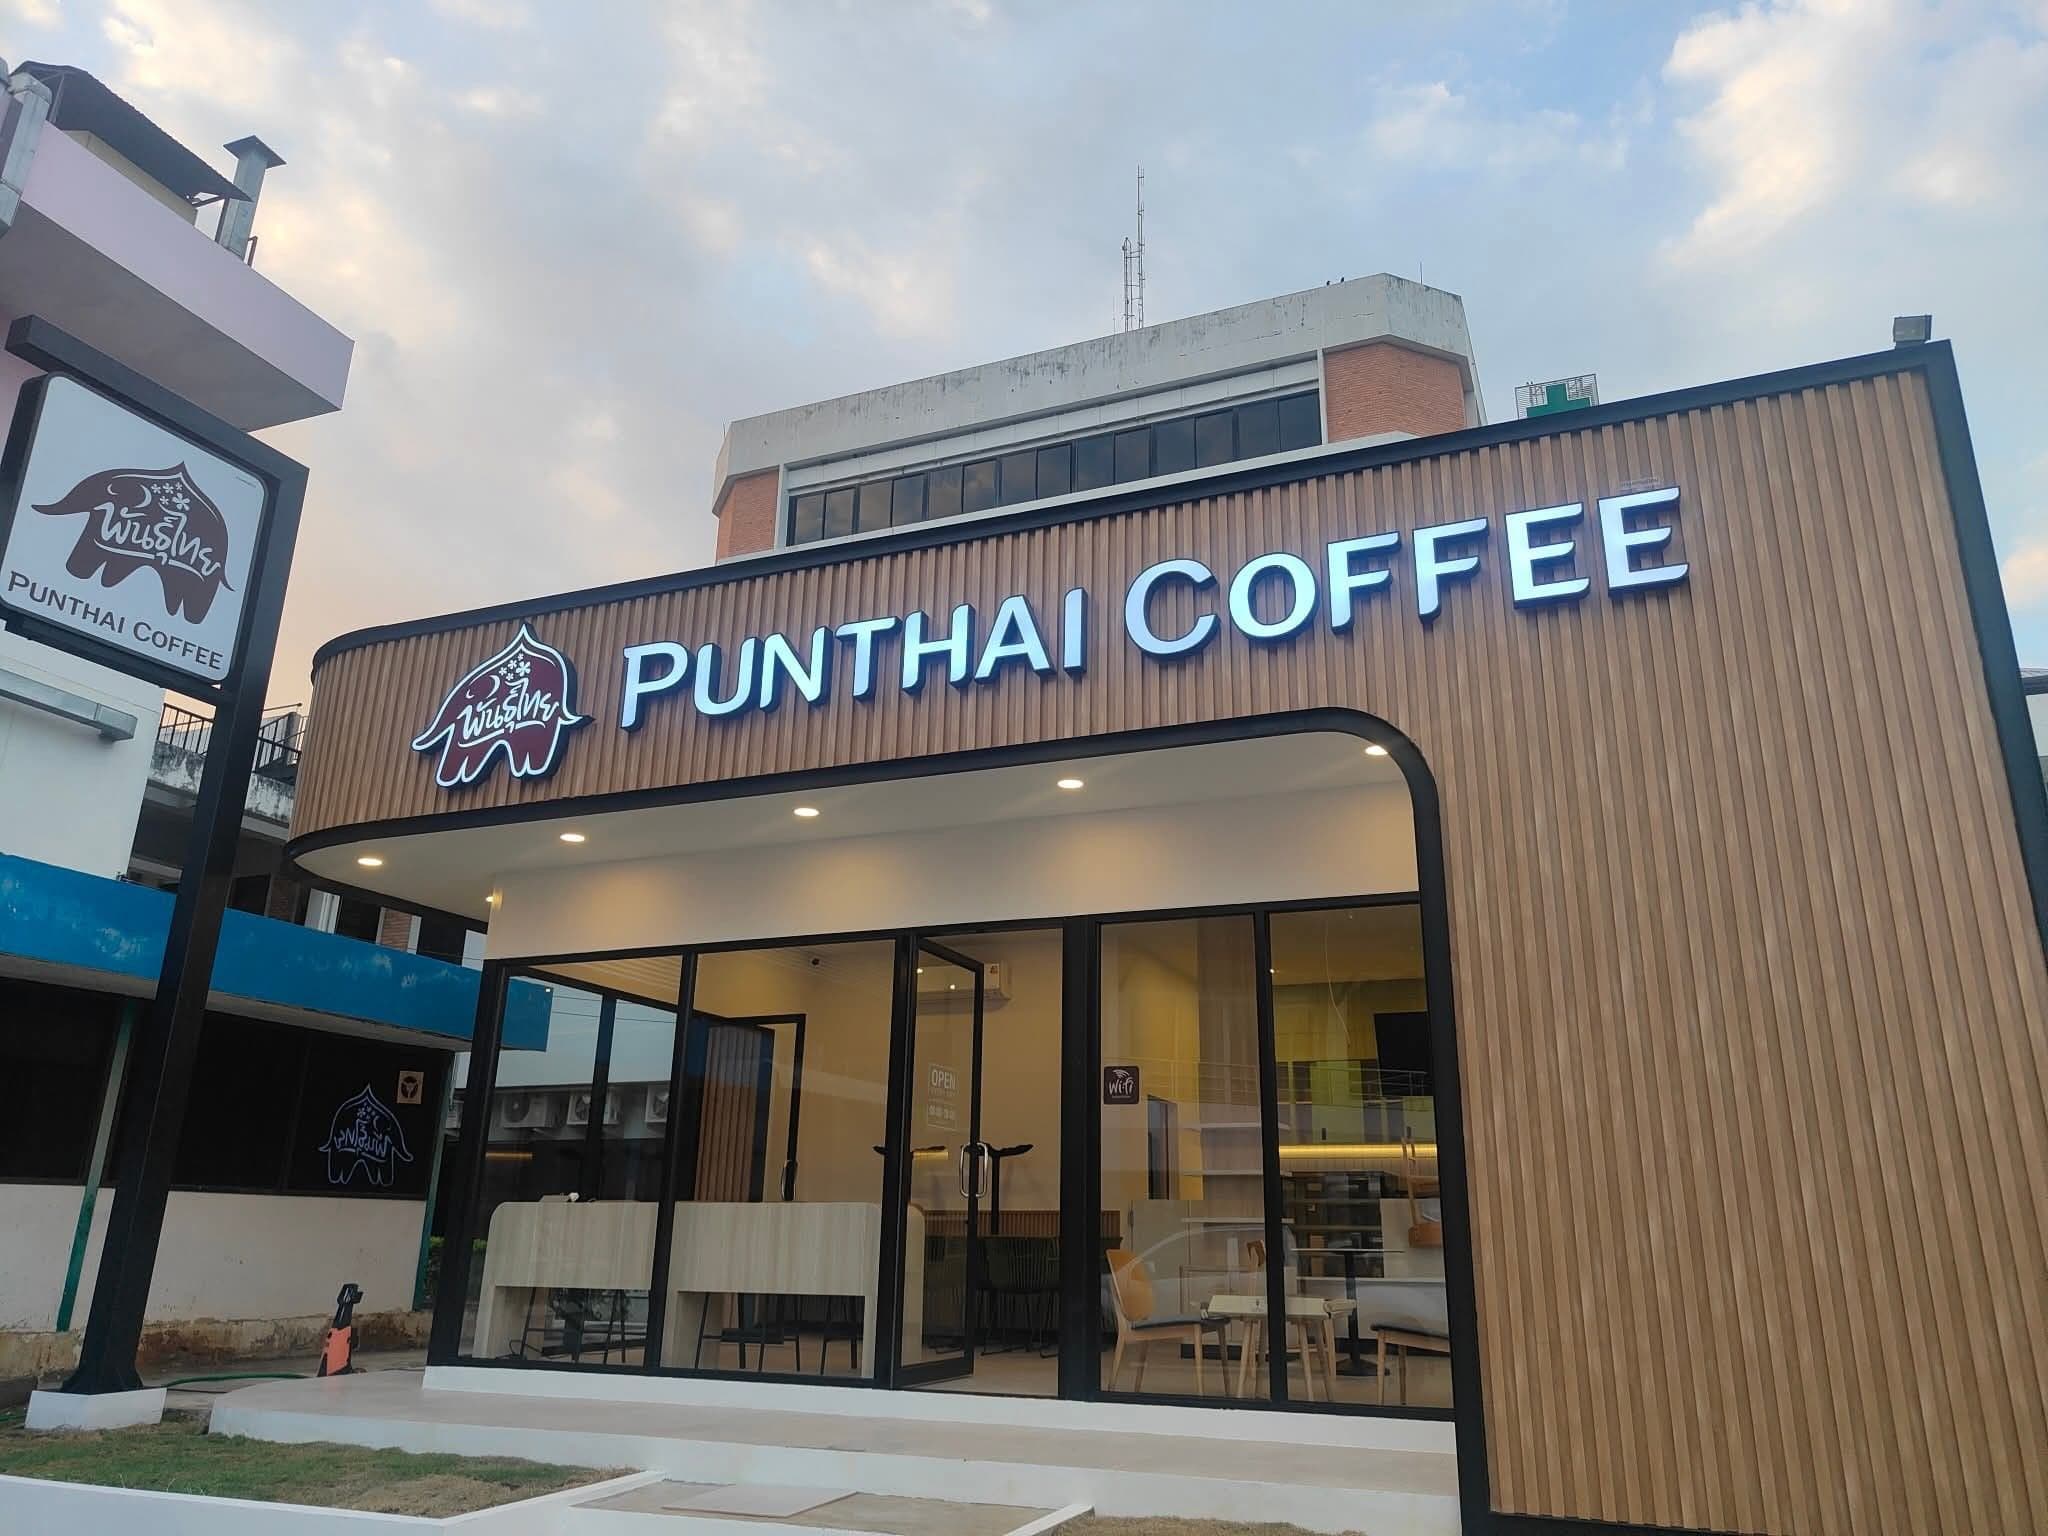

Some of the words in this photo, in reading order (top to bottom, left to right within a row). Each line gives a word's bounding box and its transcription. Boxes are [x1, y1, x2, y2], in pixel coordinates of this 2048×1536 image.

[8, 571, 125, 634] PUNTHAI
[133, 621, 224, 670] COFFEE
[621, 587, 1087, 730] PUNTHAI
[1124, 487, 1689, 658] COFFEE
[931, 1069, 957, 1090] OPEN
